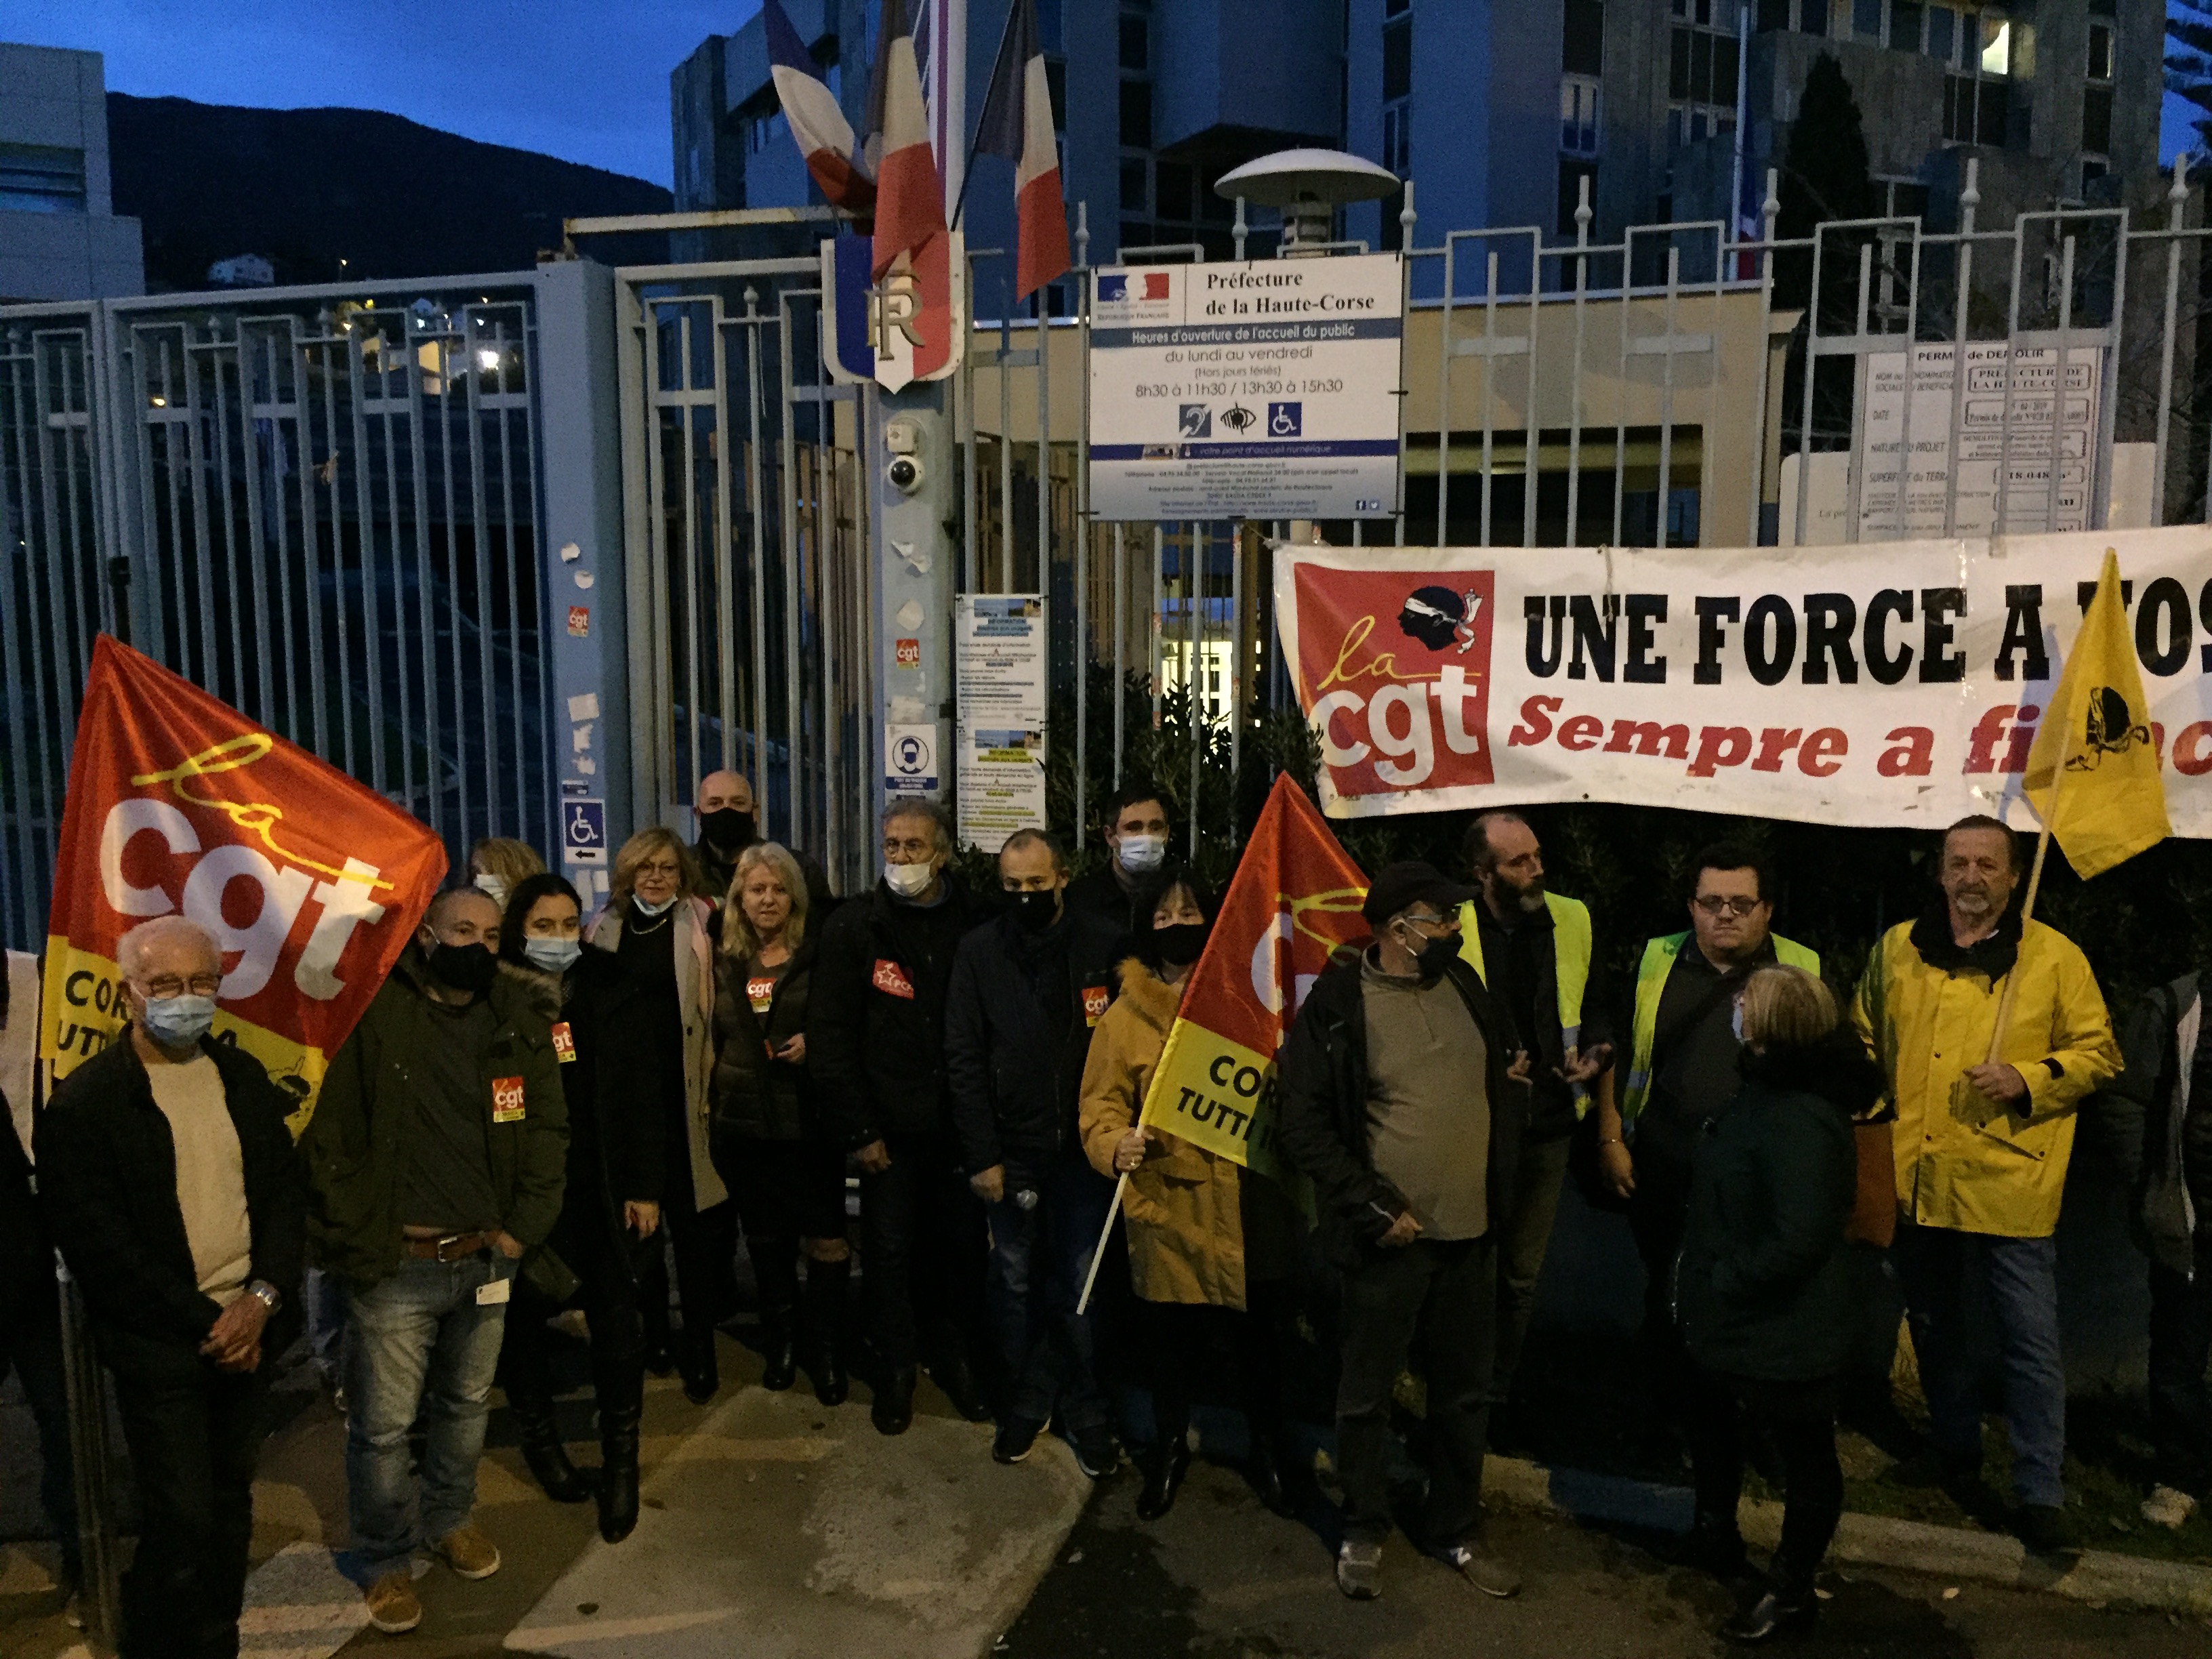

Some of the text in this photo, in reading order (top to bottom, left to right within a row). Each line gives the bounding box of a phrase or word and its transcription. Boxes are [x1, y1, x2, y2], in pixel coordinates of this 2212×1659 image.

[1207, 272, 1303, 289] Préfecture
[1206, 293, 1374, 315] de la Haute-Corse
[1132, 324, 1355, 344] Heures d'ouverture de l'accueil du public
[1165, 346, 1313, 363] du lundi au vendredi
[1919, 352, 1953, 361] PERM
[1967, 349, 1984, 359] de
[1195, 367, 1221, 379] (Hors
[1223, 367, 1247, 379] jours
[1135, 379, 1343, 398] 8h30 à 11h30 / 13h30 à 15h30
[1870, 442, 1901, 453] NATURE
[1915, 441, 1945, 453] PROJET
[569, 614, 588, 628] cgt
[1523, 594, 1669, 684] UNE
[1694, 586, 1967, 686] FORCE
[1994, 584, 2051, 681] A
[897, 645, 919, 661] cgt
[1316, 615, 1481, 692] la
[1308, 664, 1480, 786] cgt
[1507, 694, 1849, 778] Sempre
[1876, 725, 1936, 777] a
[99, 798, 387, 1000] cgt
[747, 982, 772, 998] cgt
[552, 1031, 573, 1052] gt
[494, 1085, 524, 1109] cgt
